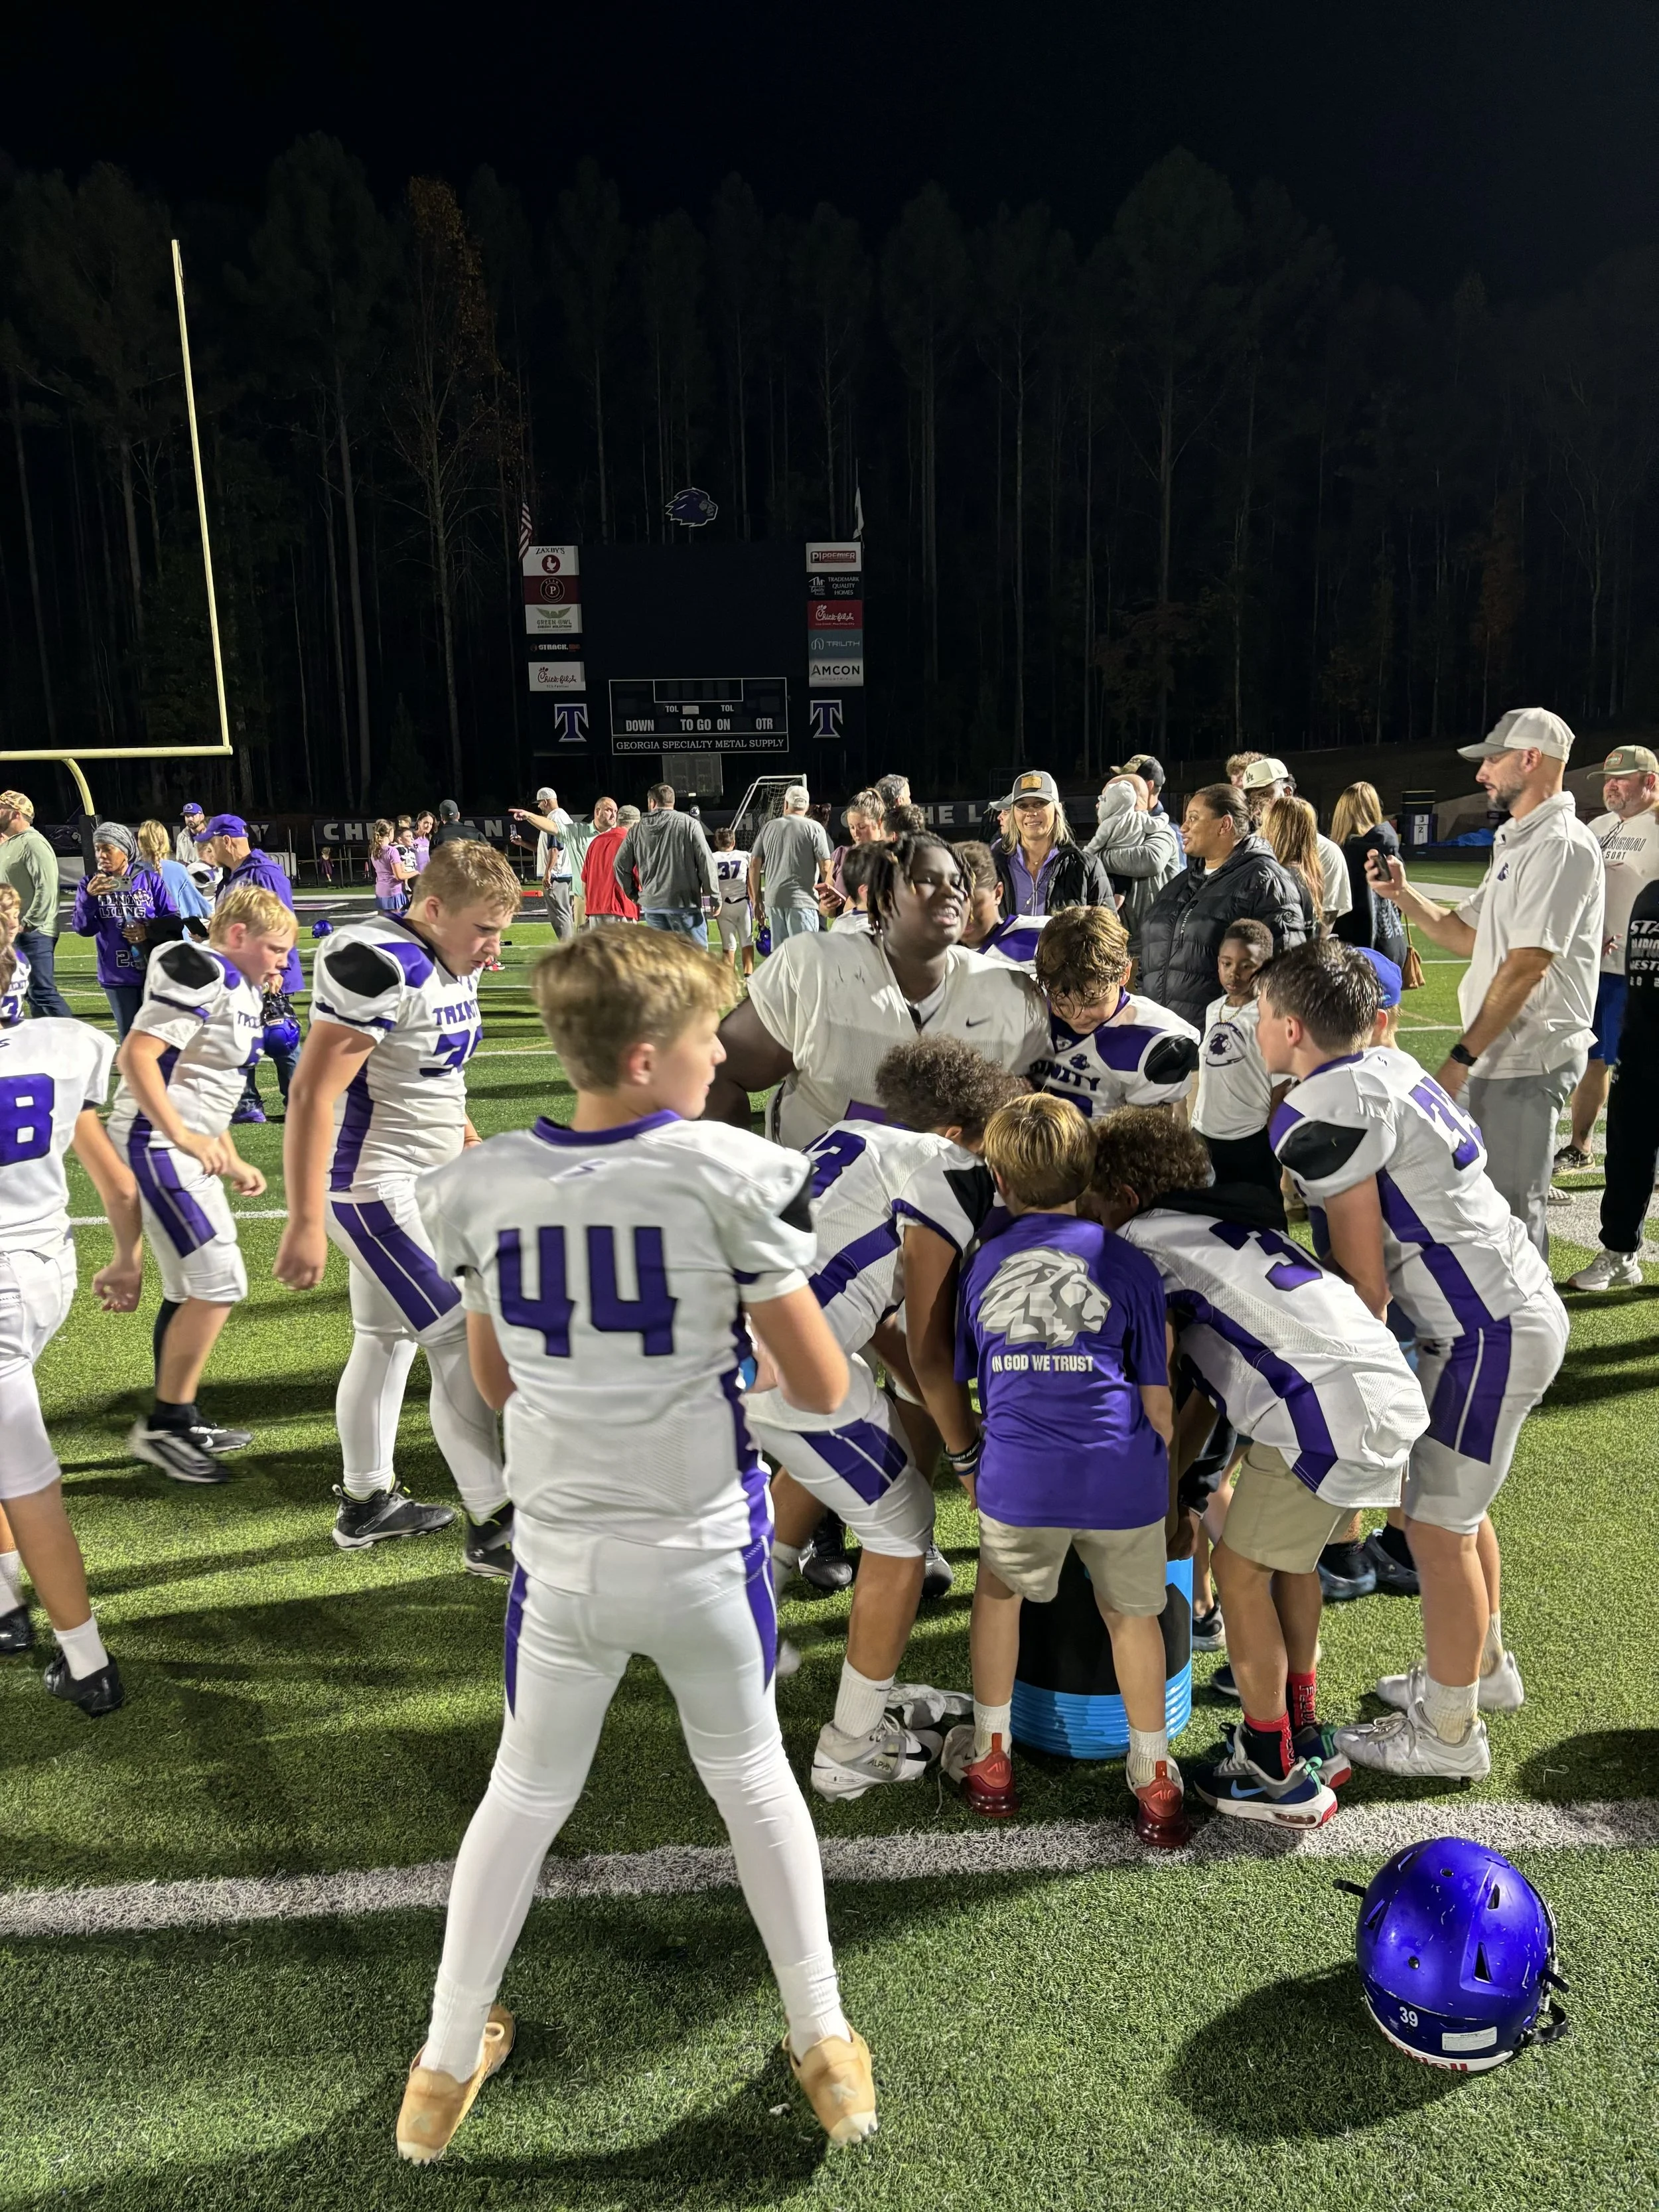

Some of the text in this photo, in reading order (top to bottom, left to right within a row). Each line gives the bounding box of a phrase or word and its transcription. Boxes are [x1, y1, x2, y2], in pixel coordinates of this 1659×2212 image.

[549, 586, 556, 595] P
[811, 664, 860, 676] AMCON
[554, 703, 589, 742] T
[625, 719, 654, 732] DOWN
[680, 719, 711, 731] TO GO
[717, 718, 730, 731] ON
[810, 700, 843, 738] T
[616, 738, 784, 750] GEORGIA SPECIALTY METAL SUPPLY
[717, 860, 741, 880] 37
[432, 998, 478, 1026] TRIN
[804, 1130, 867, 1199] 3
[1208, 1221, 1323, 1291] 3
[496, 1225, 678, 1358] 44
[991, 1355, 1094, 1372] IN GOD WE TRUST
[1399, 2006, 1418, 2028] 39
